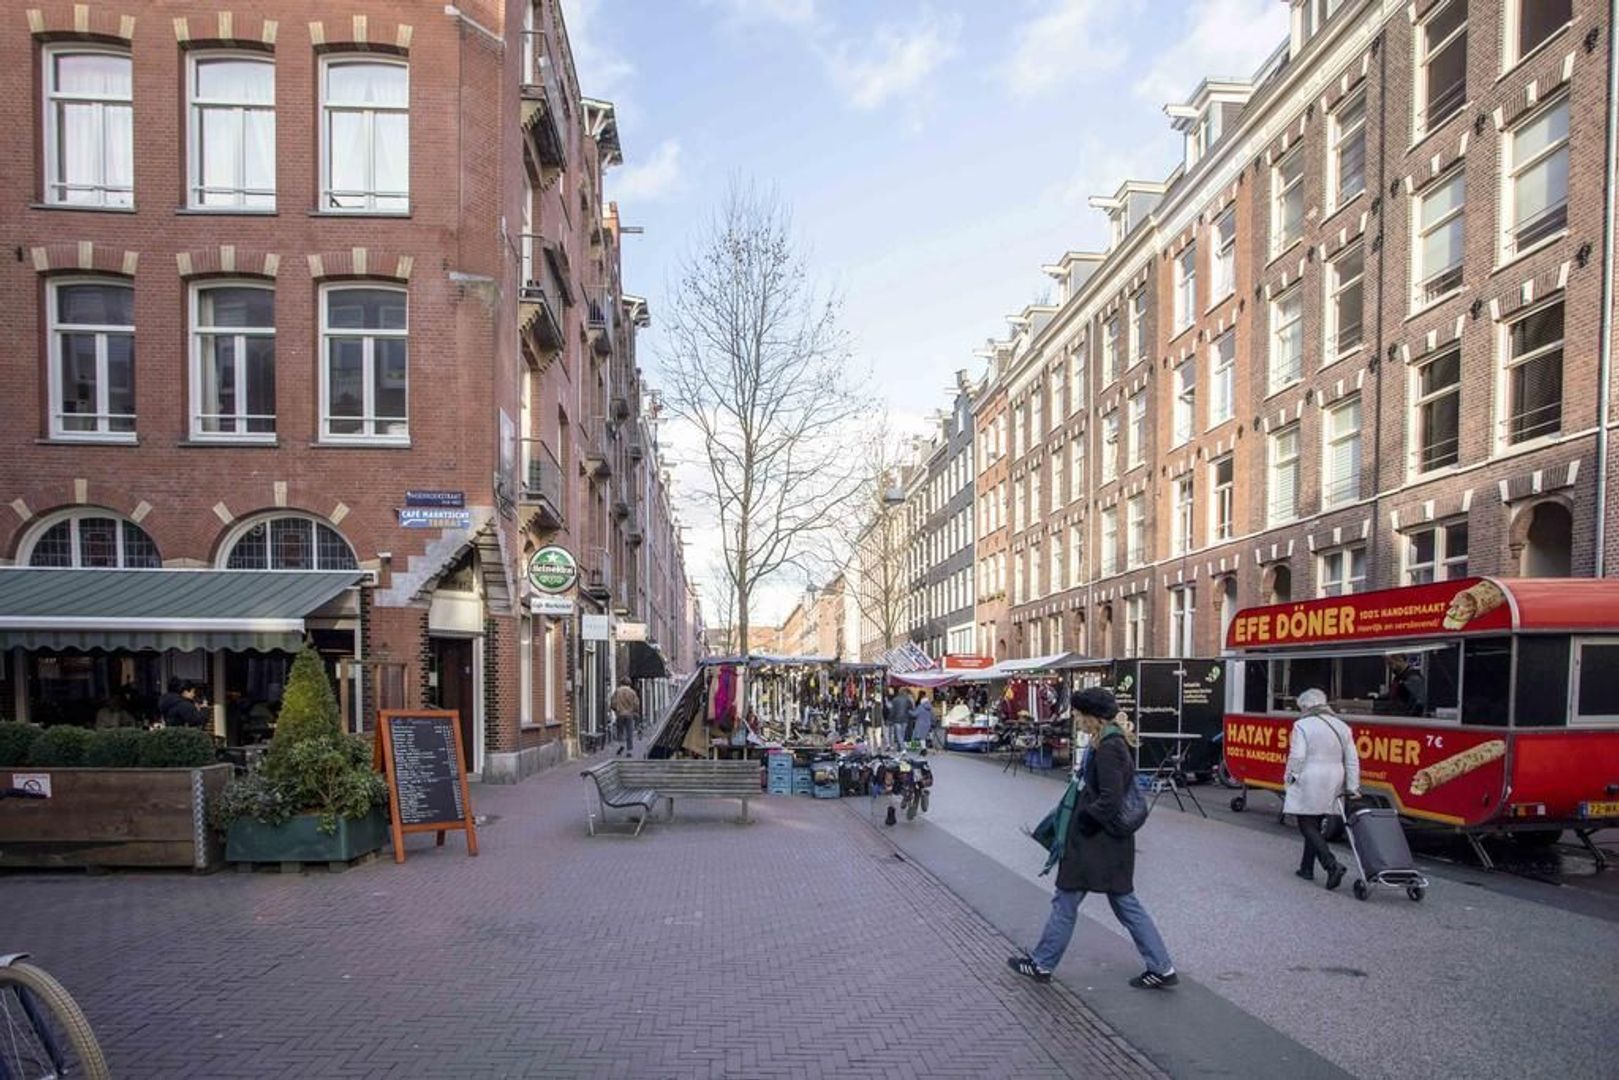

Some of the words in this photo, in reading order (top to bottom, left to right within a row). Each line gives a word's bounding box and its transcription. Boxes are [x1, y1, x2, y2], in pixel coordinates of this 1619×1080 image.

[402, 509, 420, 518] CAFÉ
[531, 564, 574, 575] Heineken
[1360, 609, 1380, 620] 100%
[1381, 602, 1446, 618] HANDGEMAAKT
[1235, 615, 1271, 642] EFE
[1275, 605, 1356, 640] DÖNER
[1227, 723, 1274, 747] HATAY
[1355, 729, 1421, 766] ÖNER
[1426, 734, 1444, 749] 7€
[1227, 745, 1245, 758] 100%
[1246, 748, 1288, 764] HANDGEMA
